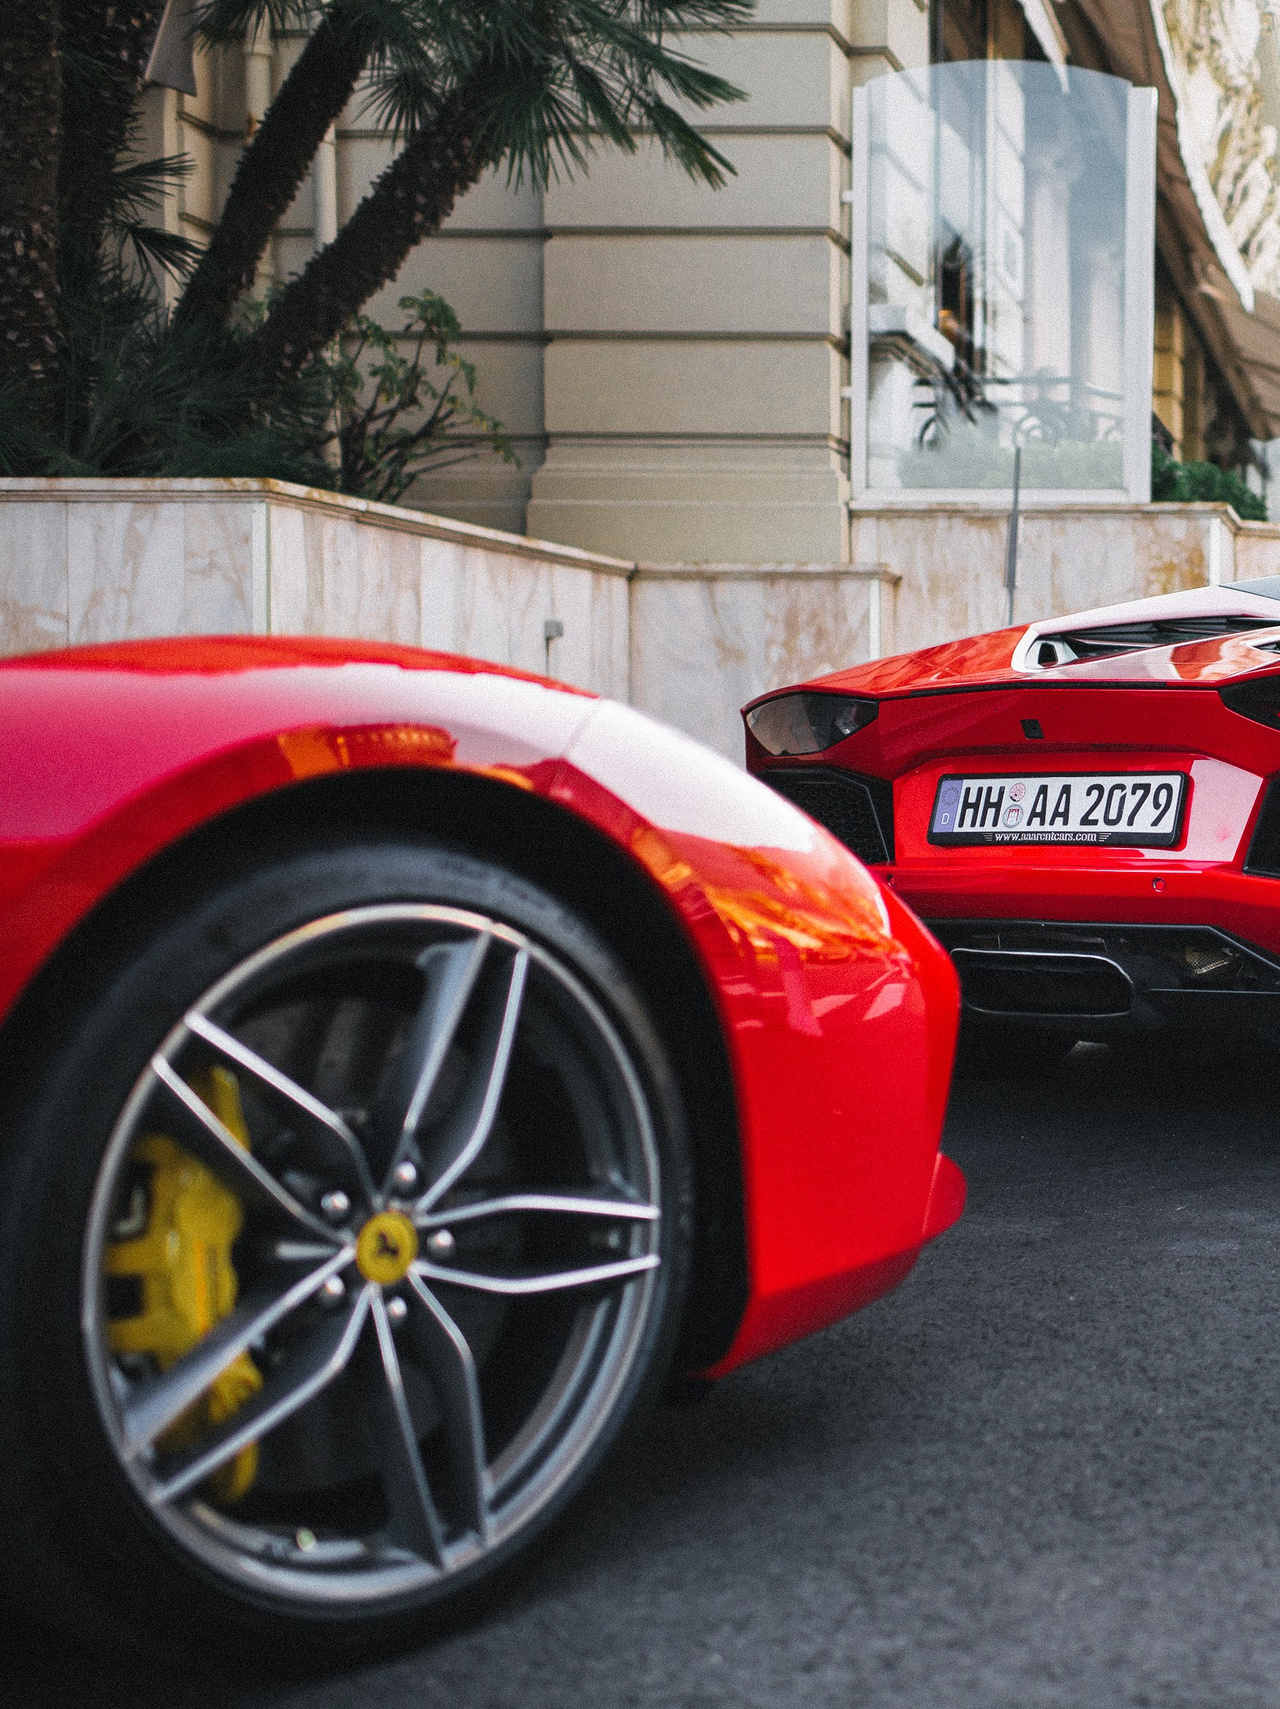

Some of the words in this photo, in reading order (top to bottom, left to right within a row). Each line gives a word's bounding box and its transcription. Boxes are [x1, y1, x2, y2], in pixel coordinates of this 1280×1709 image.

[941, 813, 950, 825] D
[958, 786, 1004, 828] HH
[1026, 784, 1070, 827] AA
[1080, 783, 1173, 827] 2079
